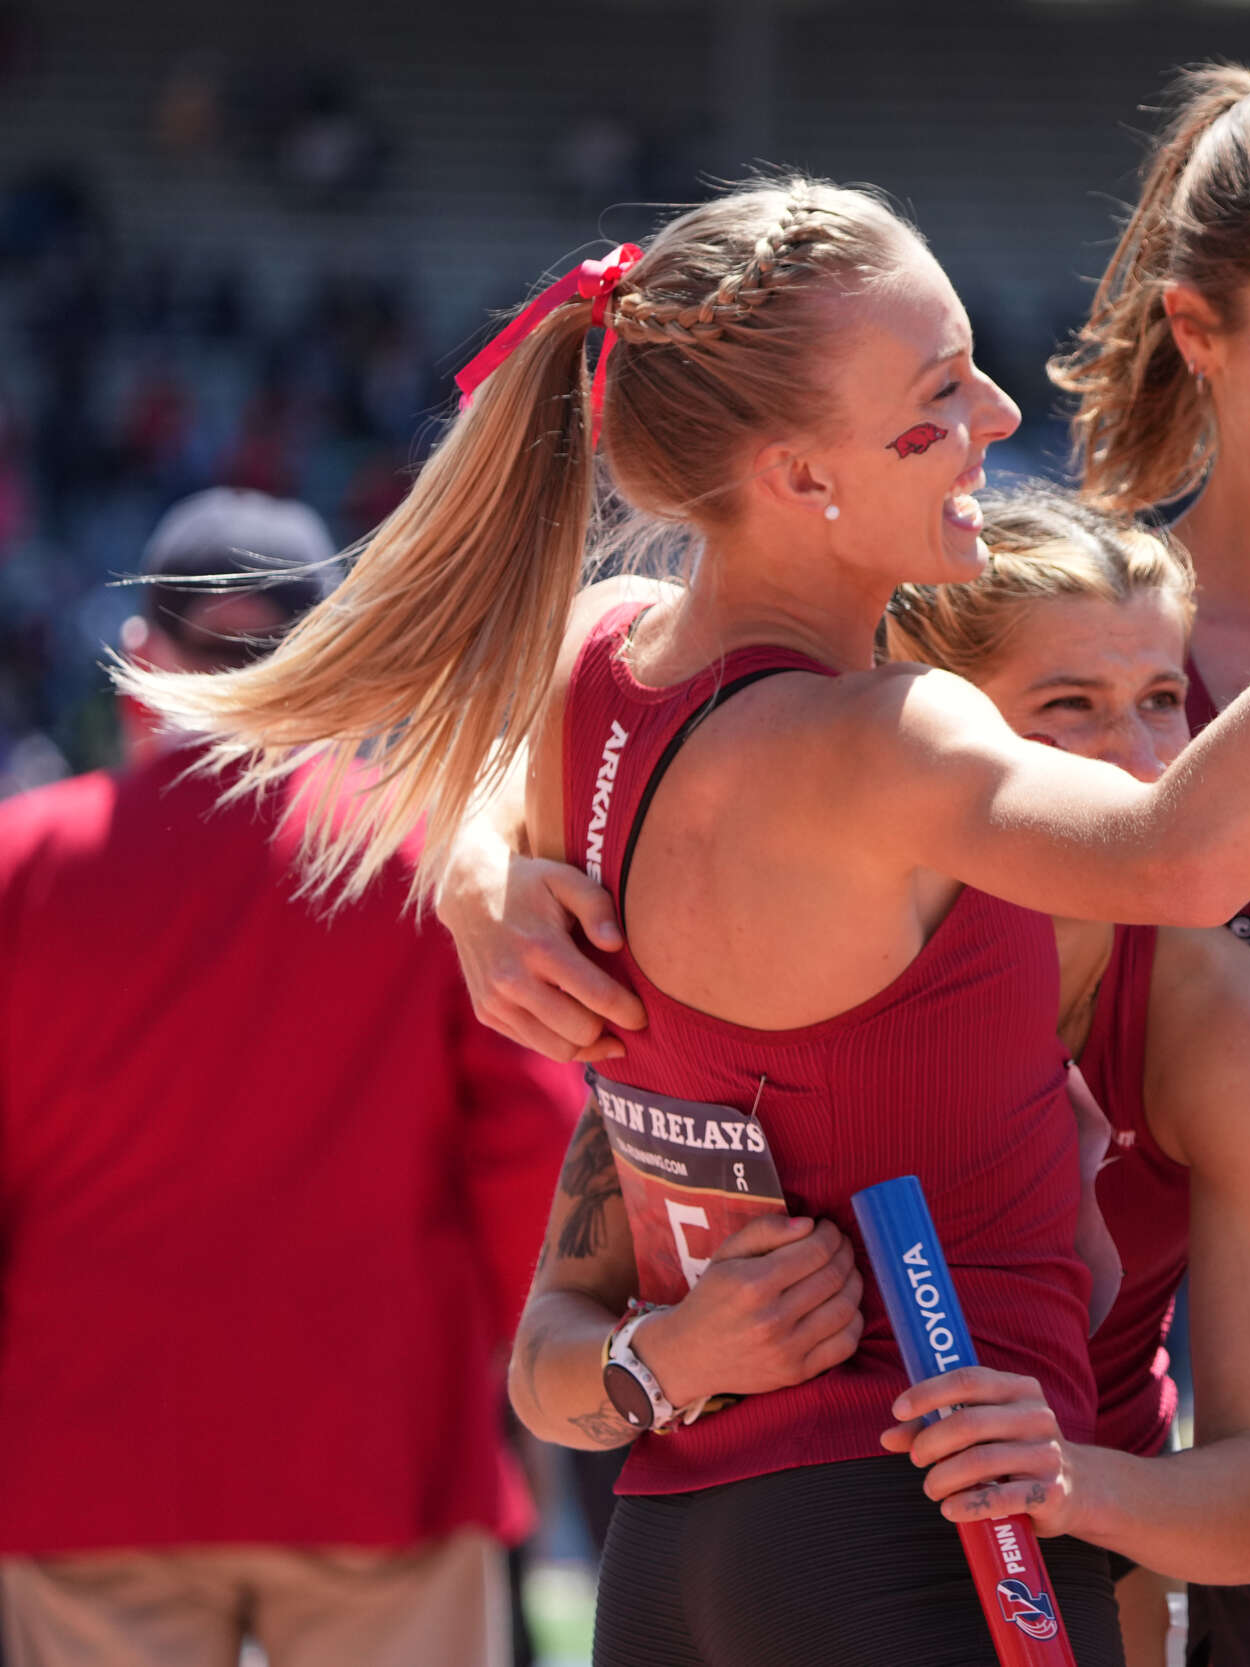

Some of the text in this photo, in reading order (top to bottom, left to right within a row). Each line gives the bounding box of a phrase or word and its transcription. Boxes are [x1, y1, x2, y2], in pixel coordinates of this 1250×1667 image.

[648, 1106, 766, 1154] RELAYS
[902, 1241, 960, 1373] TOYOTA
[993, 1523, 1027, 1575] PENN
